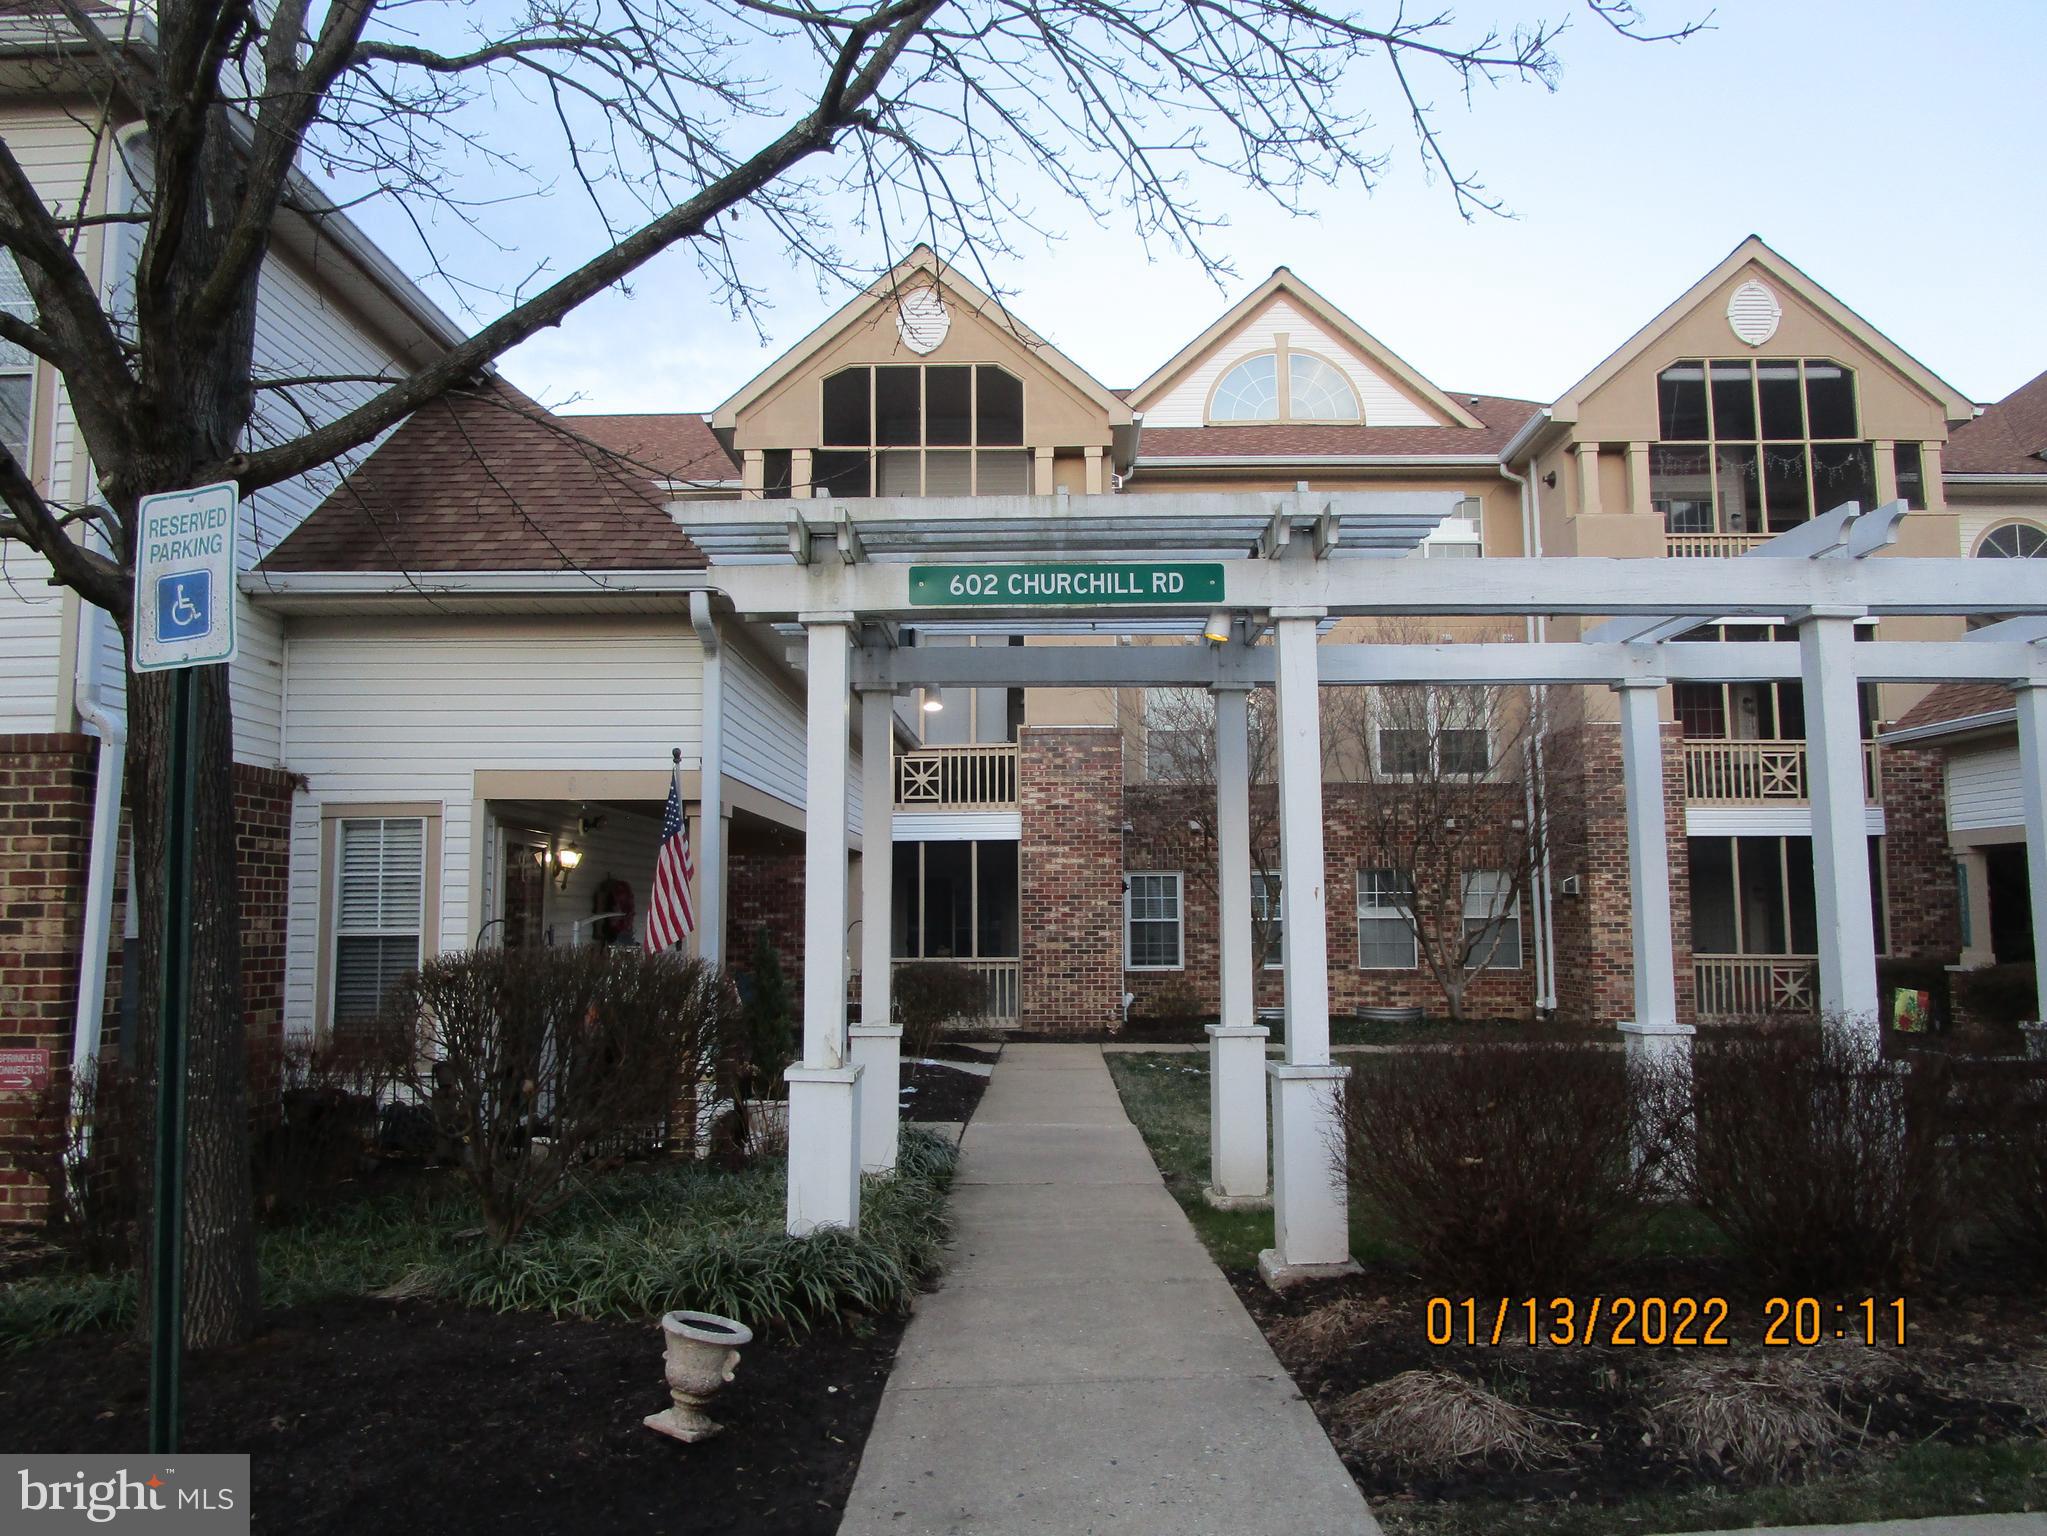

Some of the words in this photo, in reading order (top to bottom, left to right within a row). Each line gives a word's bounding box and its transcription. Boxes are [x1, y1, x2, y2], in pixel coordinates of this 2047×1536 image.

[149, 507, 226, 538] RESERVED
[150, 534, 222, 564] PARKING
[949, 573, 999, 596] 602
[1007, 572, 1144, 595] CHURCHILL
[1152, 572, 1185, 593] RD
